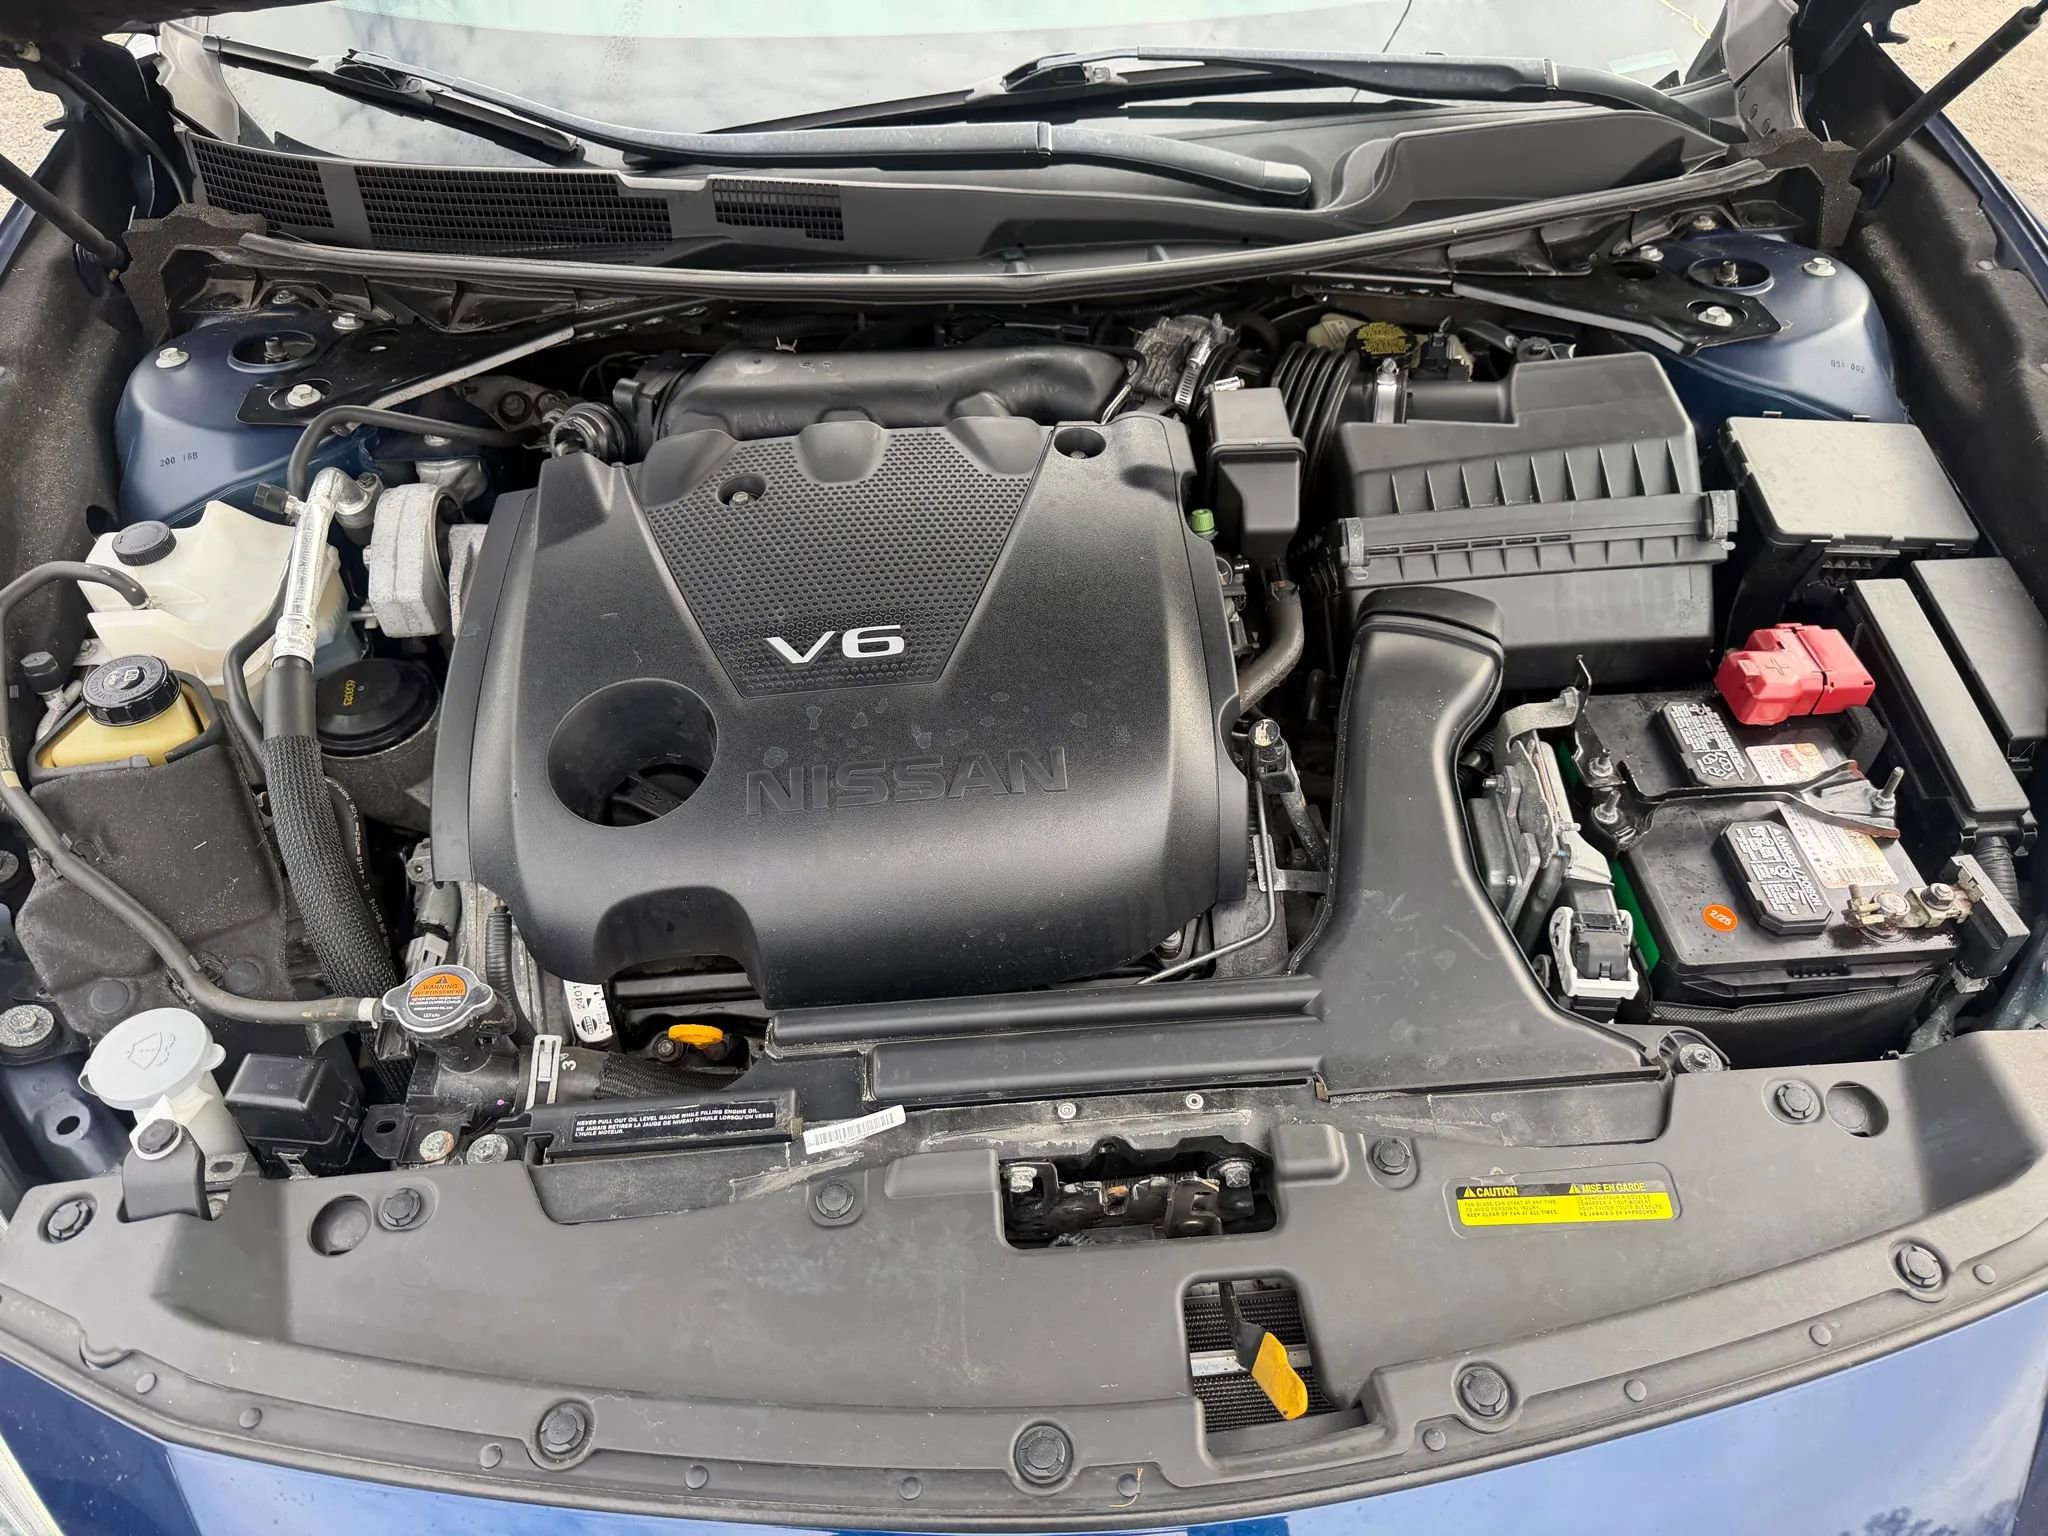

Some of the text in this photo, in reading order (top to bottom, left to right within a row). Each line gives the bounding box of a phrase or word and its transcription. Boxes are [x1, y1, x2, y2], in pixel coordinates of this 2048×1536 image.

[160, 456, 176, 467] 200
[764, 624, 905, 664] V6
[746, 746, 1068, 816] NISSAN
[1777, 836, 1800, 868] DANGER
[1799, 876, 1822, 906] POISON
[1709, 910, 1732, 926] 2/25
[562, 1060, 576, 1070] 3
[1476, 1187, 1518, 1197] CAUTION
[1582, 1183, 1646, 1193] MISE EN GARDE
